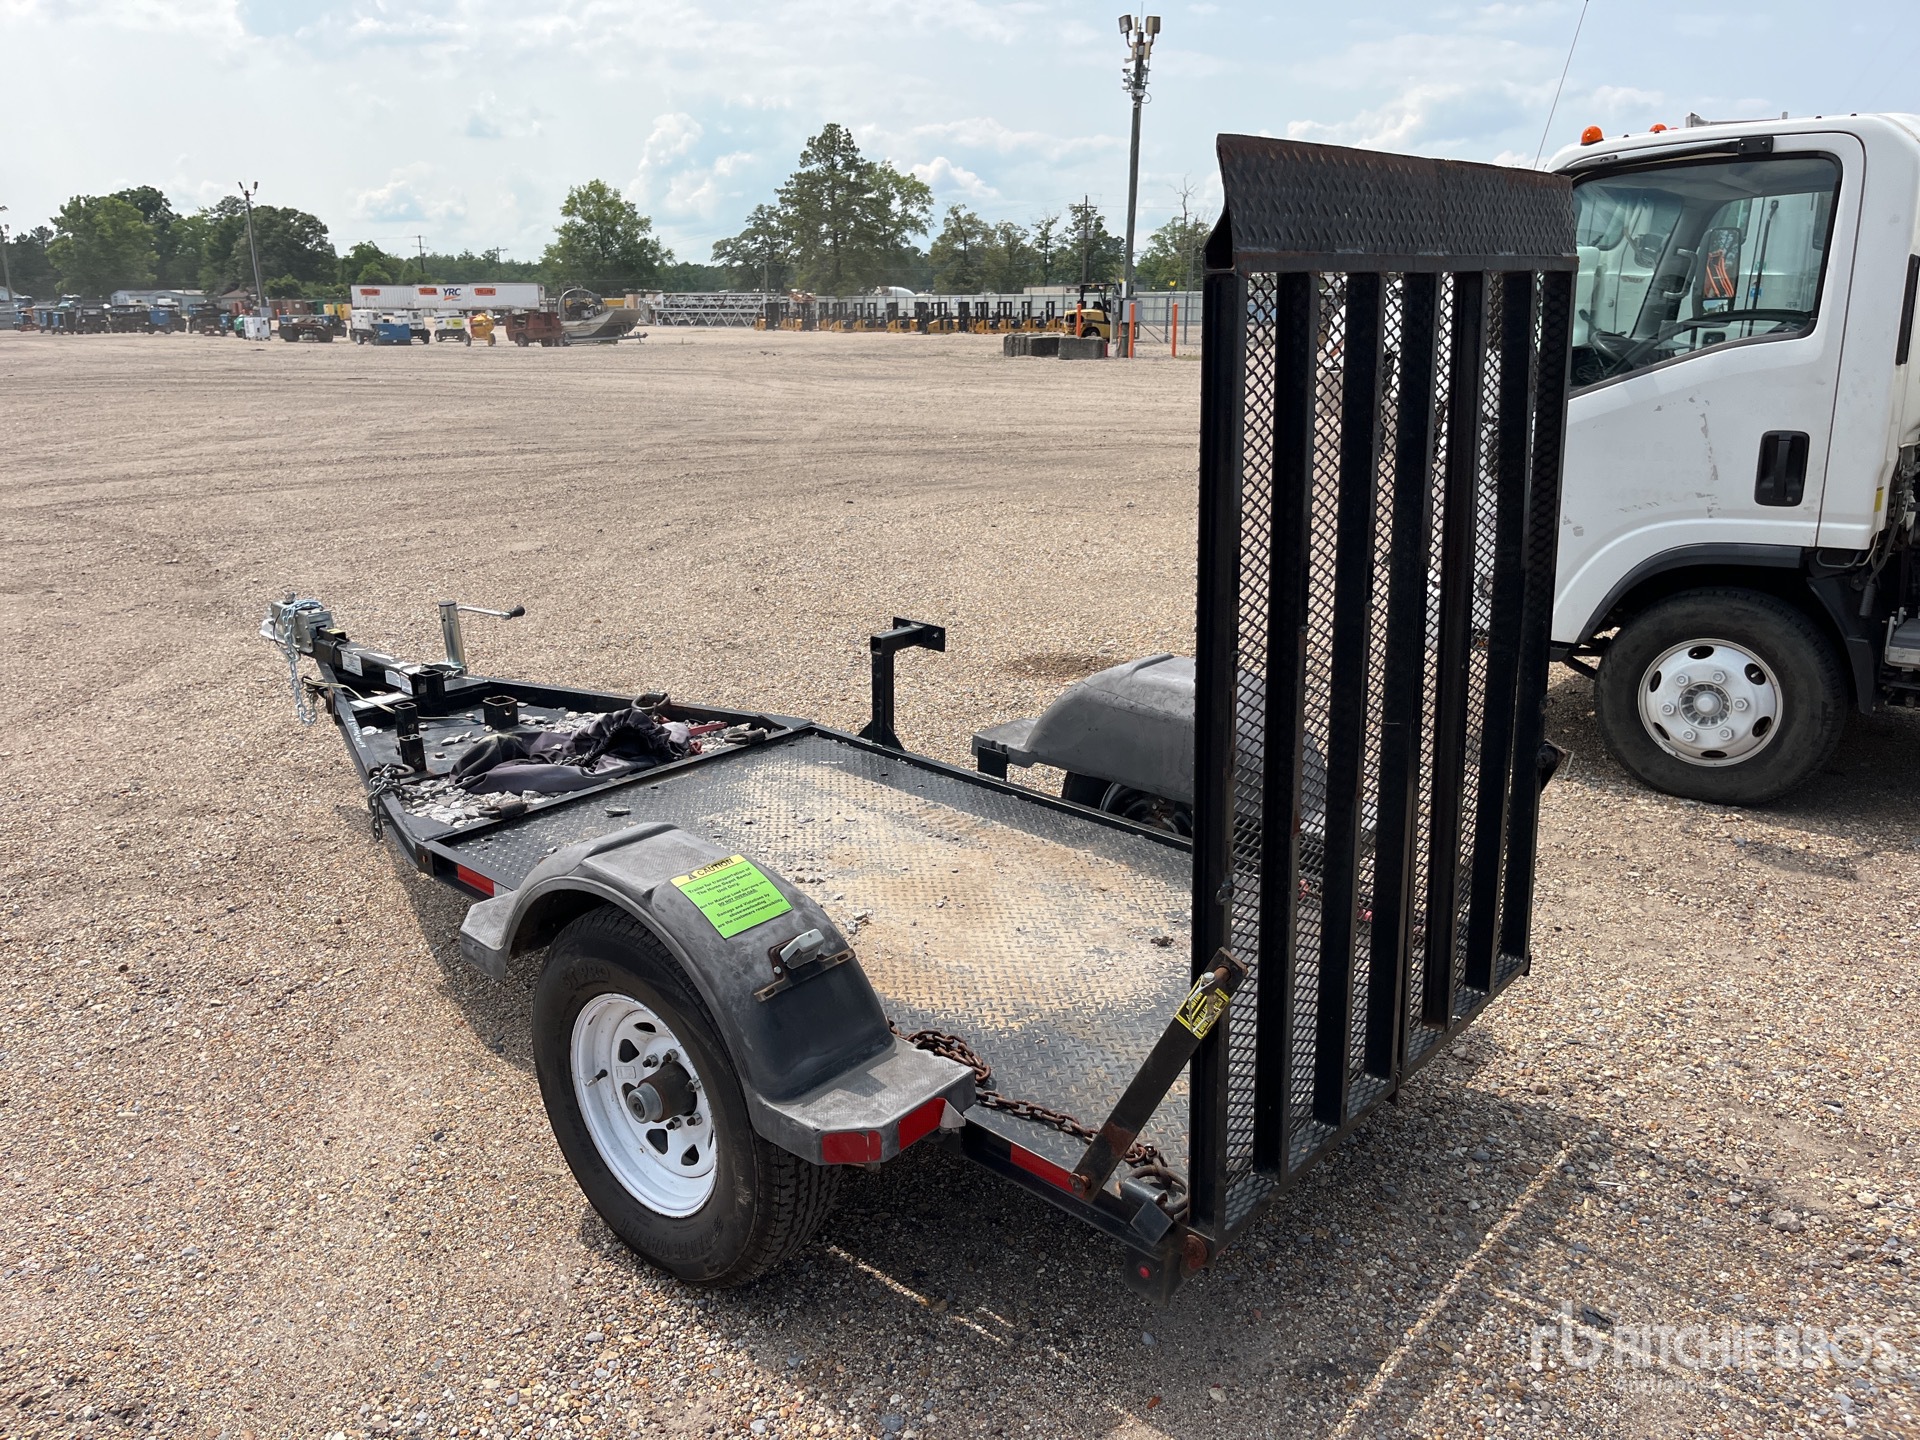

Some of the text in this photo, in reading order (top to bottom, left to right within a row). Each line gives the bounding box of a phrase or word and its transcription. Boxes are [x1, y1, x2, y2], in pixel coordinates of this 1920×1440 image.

[443, 288, 461, 296] YRC
[697, 858, 734, 876] CAUTION
[706, 884, 722, 892] Home
[721, 878, 737, 886] Depot
